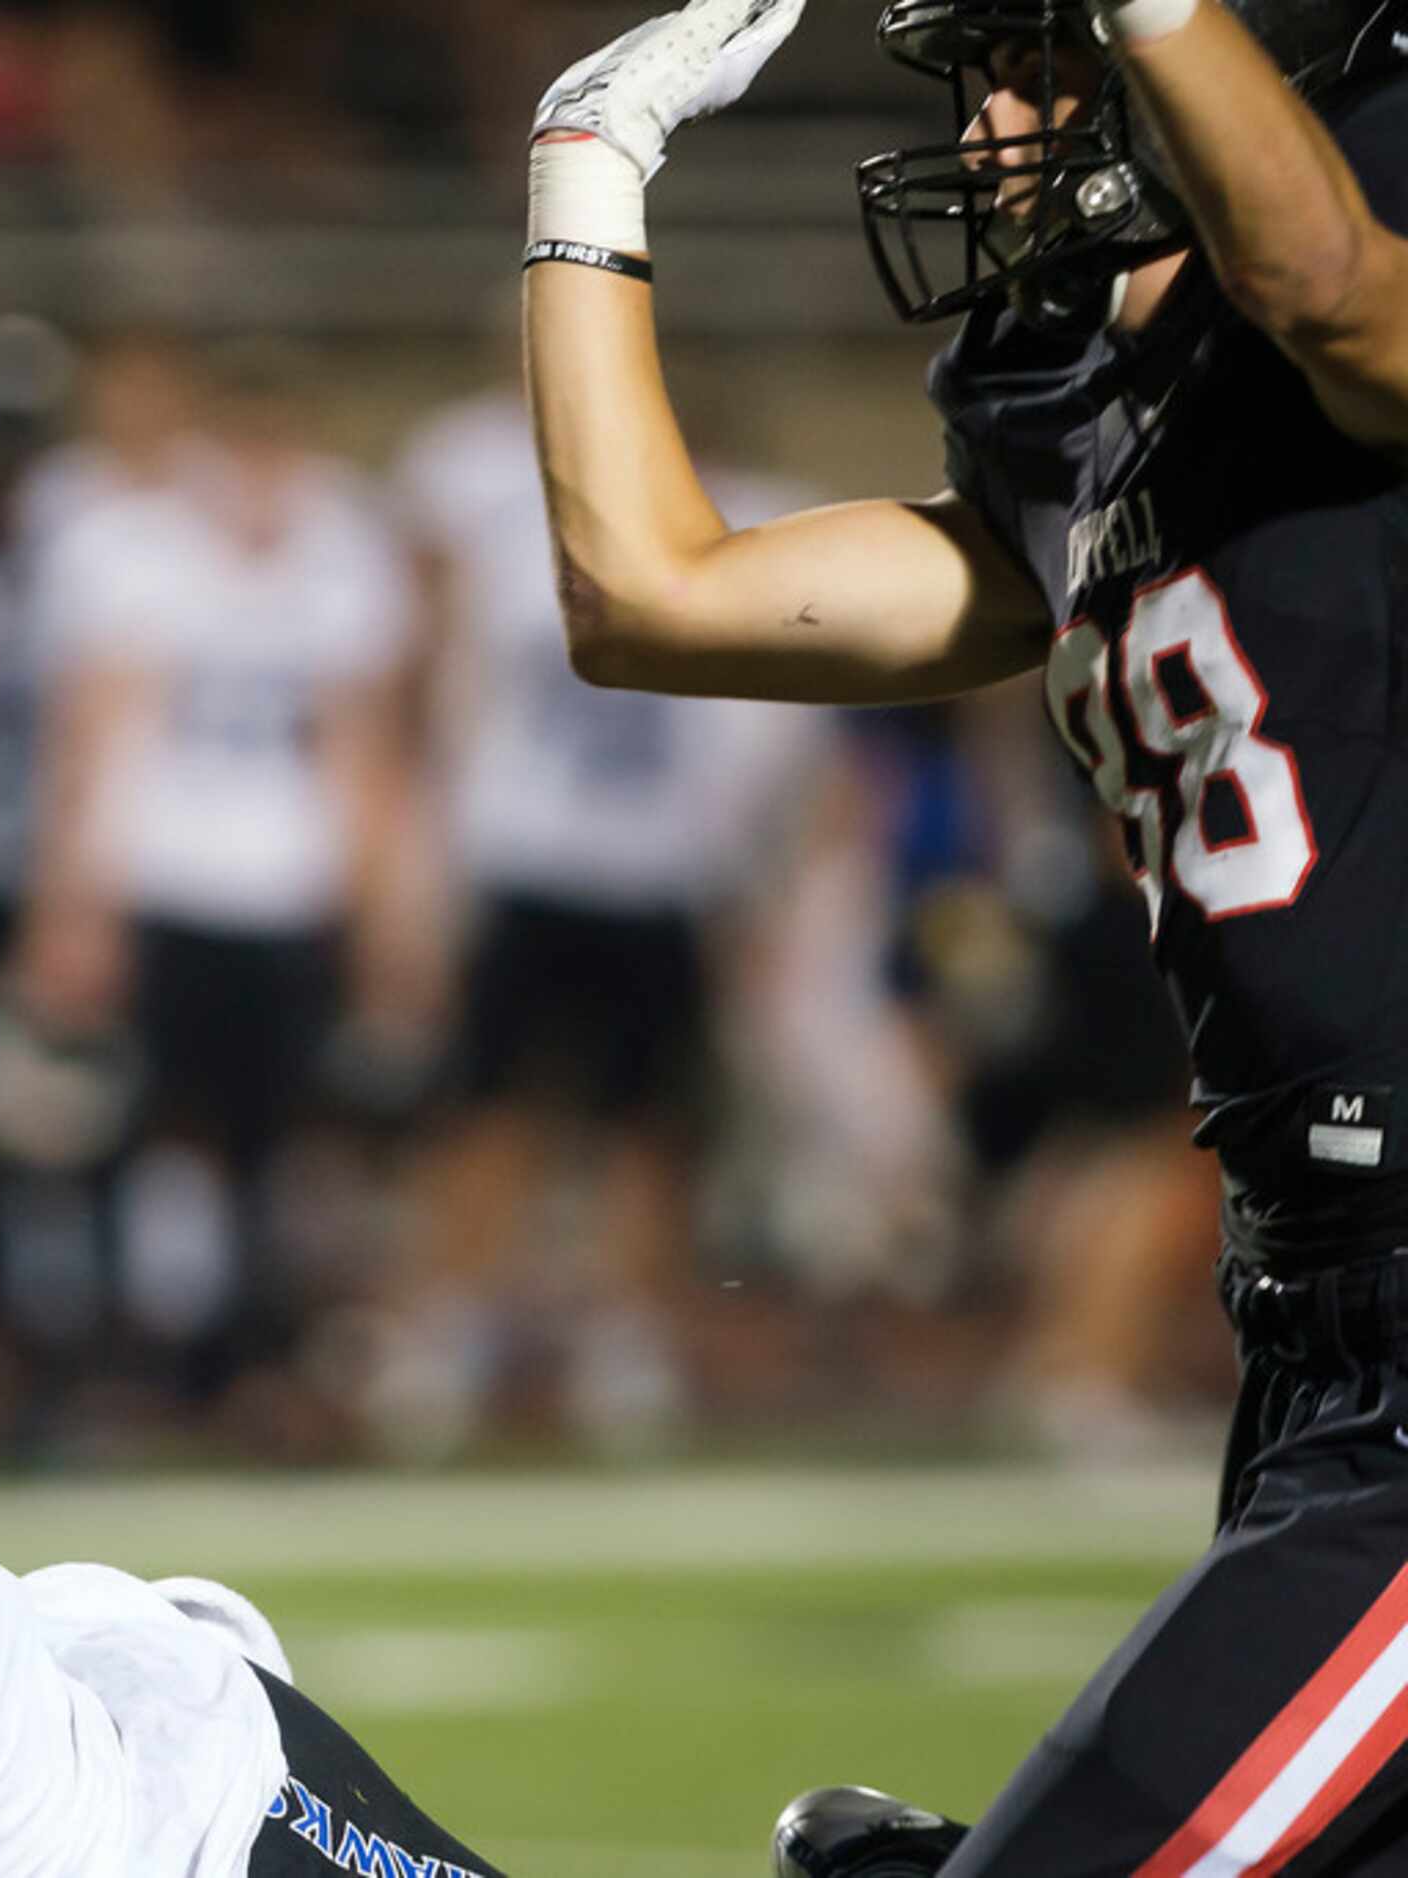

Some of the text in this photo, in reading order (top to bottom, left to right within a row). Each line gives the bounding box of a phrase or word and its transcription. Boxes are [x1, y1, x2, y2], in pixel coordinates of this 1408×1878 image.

[527, 243, 552, 258] AM
[1331, 1094, 1365, 1123] M
[266, 1775, 487, 1878] AWK
